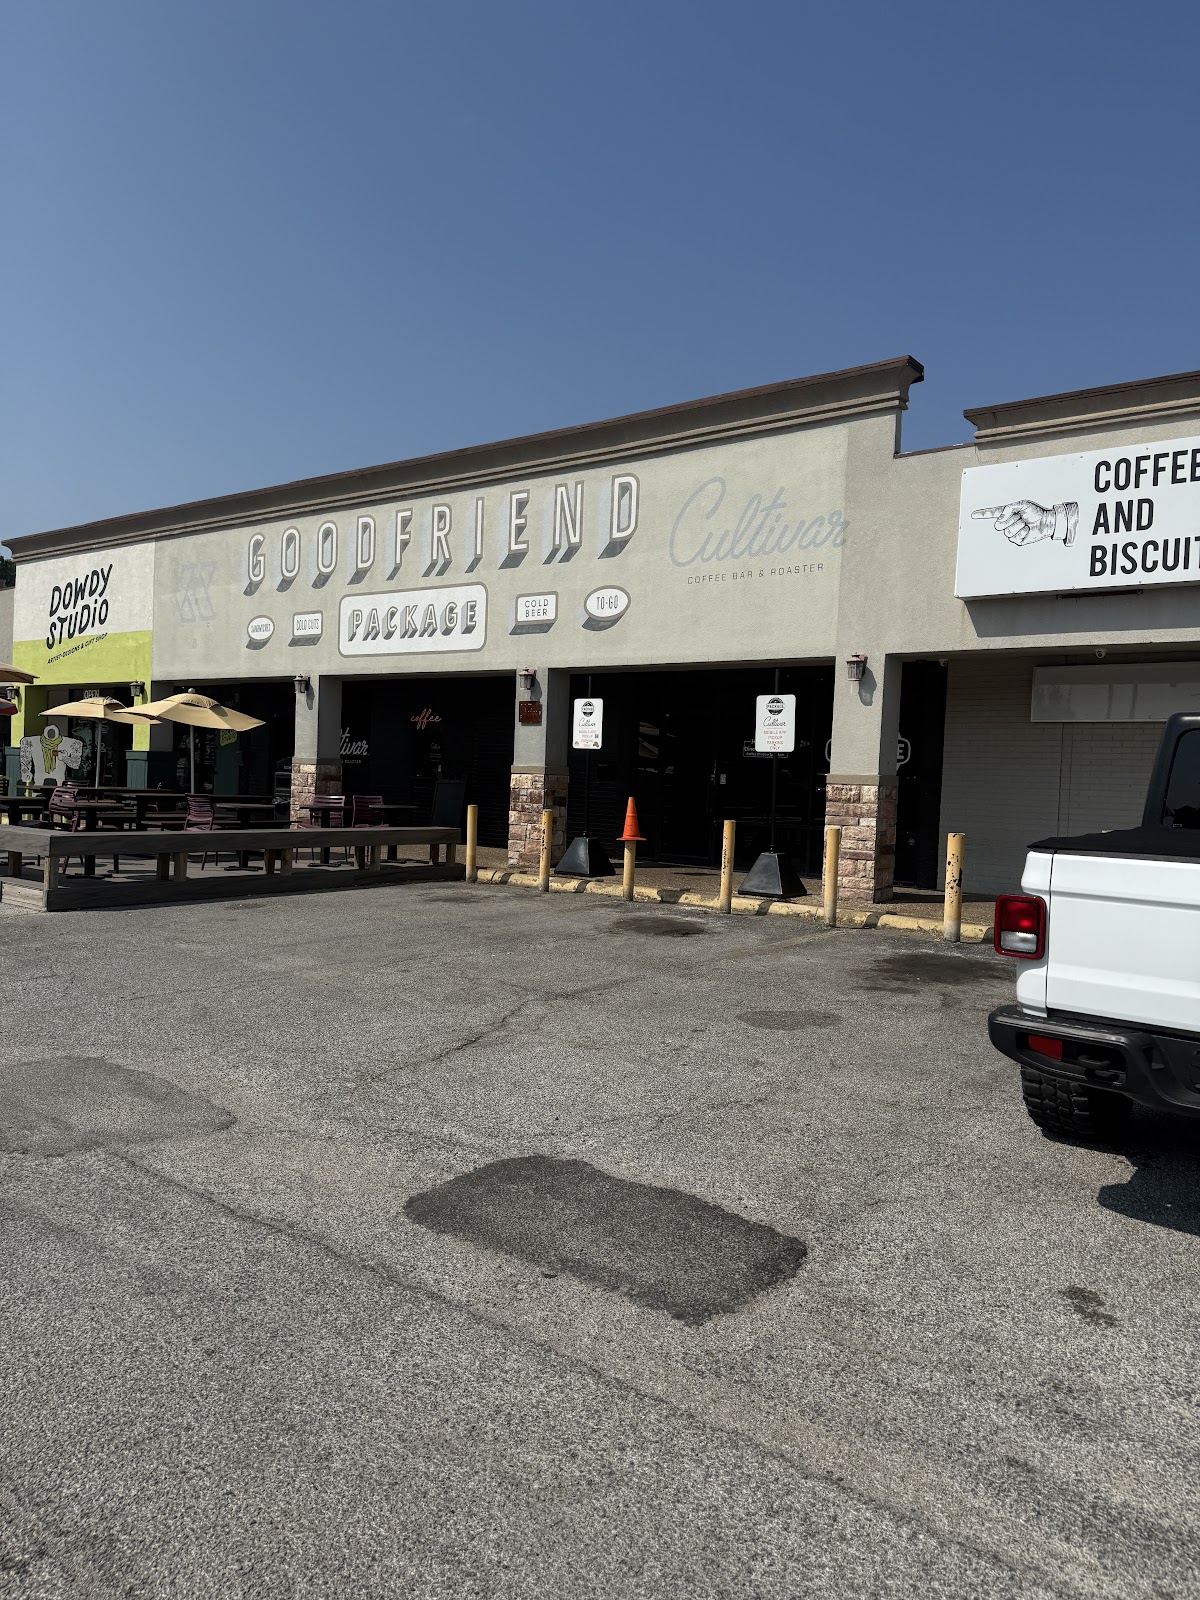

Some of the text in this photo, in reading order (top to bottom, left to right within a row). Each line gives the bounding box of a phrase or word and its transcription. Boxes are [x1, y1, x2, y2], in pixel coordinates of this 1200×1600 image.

[1094, 448, 1200, 493] COFFEE
[246, 473, 641, 588] GOODFRIEND
[669, 476, 850, 568] Cultivar
[1092, 498, 1154, 536] AND
[49, 563, 113, 618] DOWDY
[687, 562, 824, 585] COFFEE BAR & ROASTER
[347, 600, 478, 643] PACKAGE
[524, 598, 549, 608] COLD
[525, 608, 548, 618] BEER
[410, 708, 442, 730] coffee
